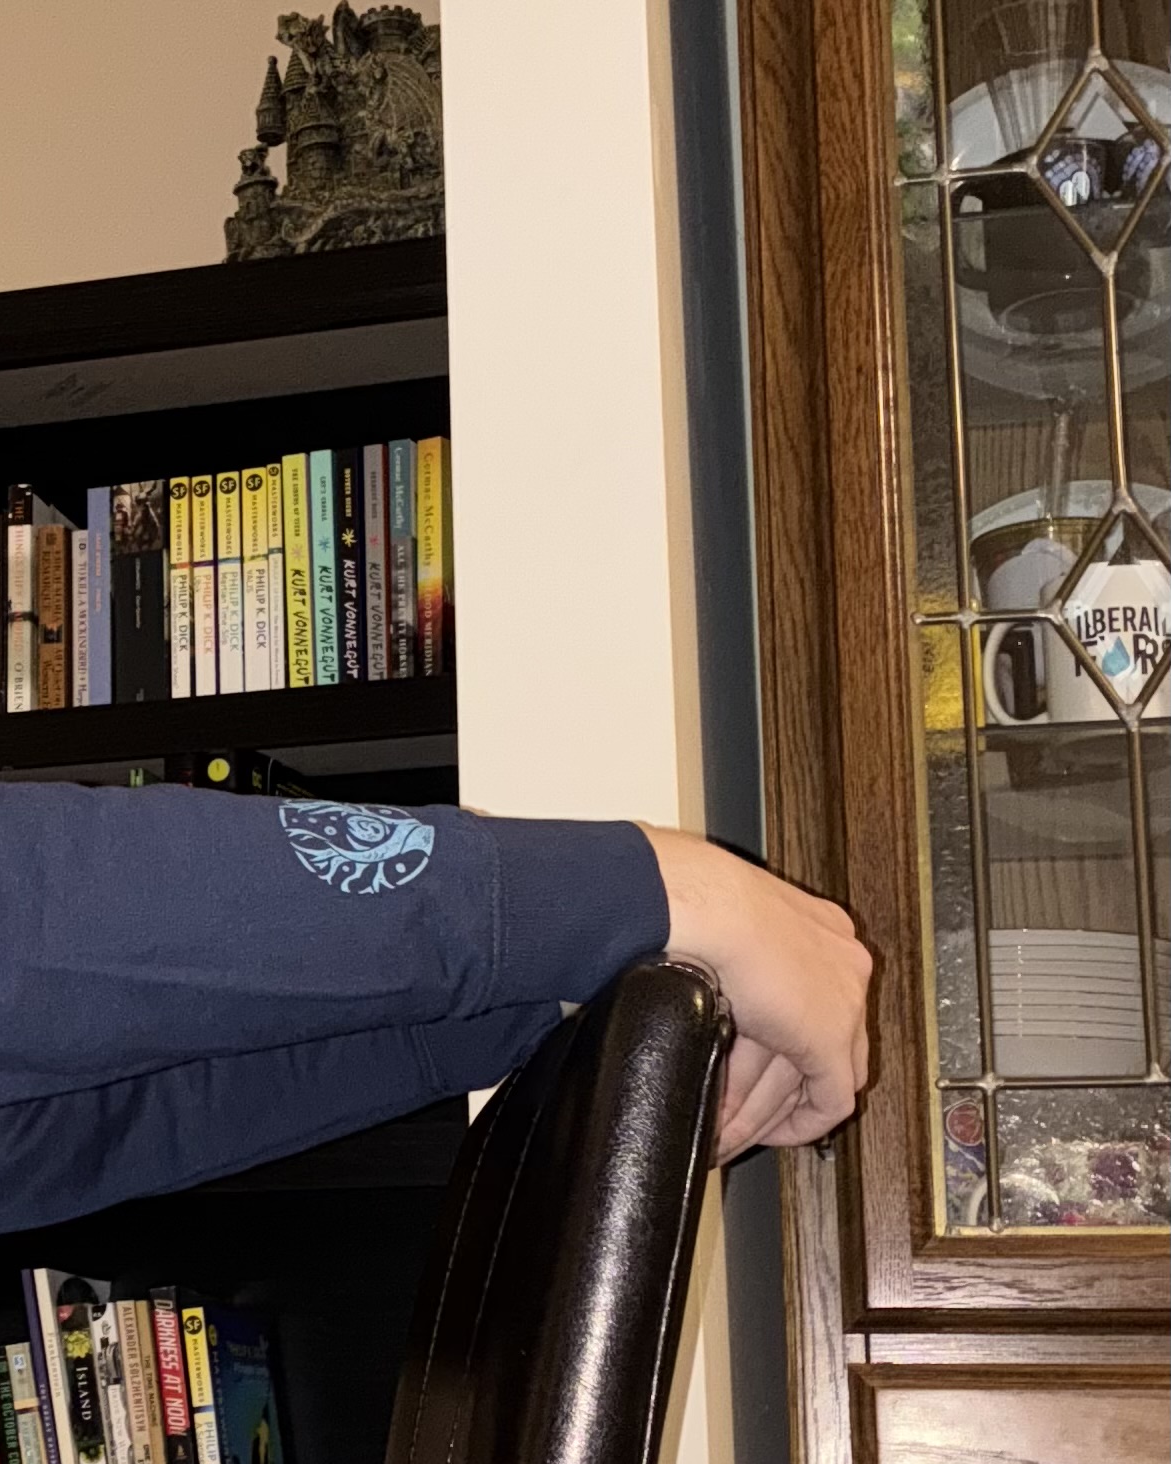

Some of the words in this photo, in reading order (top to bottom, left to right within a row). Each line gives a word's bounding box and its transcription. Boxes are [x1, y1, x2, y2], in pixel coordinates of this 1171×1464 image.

[171, 486, 187, 497] SF
[194, 483, 210, 495] SF
[220, 480, 236, 492] SF
[247, 476, 262, 488] SF
[422, 453, 434, 500] Cormac
[14, 499, 25, 520] THE
[251, 494, 259, 552] MASTERWORKS
[271, 479, 279, 537] MASTERWORKS
[175, 503, 184, 562] MASTERWORKS
[198, 501, 206, 558] MASTERWORKS
[422, 506, 435, 567] McCarthy
[397, 545, 405, 565] ALL
[178, 574, 188, 609] PHILIP
[203, 574, 213, 610] PHILIP
[229, 572, 239, 607] PHILIP
[256, 568, 266, 604] PHILIP
[290, 568, 306, 606] KURT
[318, 565, 334, 602] KURT
[343, 559, 357, 596] KURT
[369, 562, 381, 600] KURT
[178, 625, 188, 652] DICK
[202, 626, 213, 654] DICK
[229, 624, 238, 652] DICK
[256, 621, 266, 649] DICK
[292, 611, 310, 685] VONNEGUT
[320, 608, 336, 683] VONNEGUT
[343, 601, 360, 679] VONNEGUT
[369, 605, 384, 680] VONNEGUT
[14, 662, 25, 711] O'BRIEN
[122, 1306, 137, 1360] ALEXANDER
[153, 1300, 180, 1369] DARKNESS
[186, 1319, 201, 1333] SF
[47, 1332, 63, 1398] Frankenstein
[143, 1355, 152, 1371] THE
[145, 1372, 155, 1391] TIME
[192, 1338, 205, 1404] MASTERWORKS
[0, 1380, 11, 1400] THE
[38, 1384, 46, 1400] THE
[74, 1366, 92, 1421] ISLAND
[128, 1362, 146, 1432] SOLZHENITSYN
[164, 1374, 183, 1392] AT
[1, 1402, 17, 1449] OCTOBER
[147, 1393, 158, 1428] MACHINE
[166, 1398, 188, 1437] NOON
[204, 1421, 217, 1461] PHILIP
